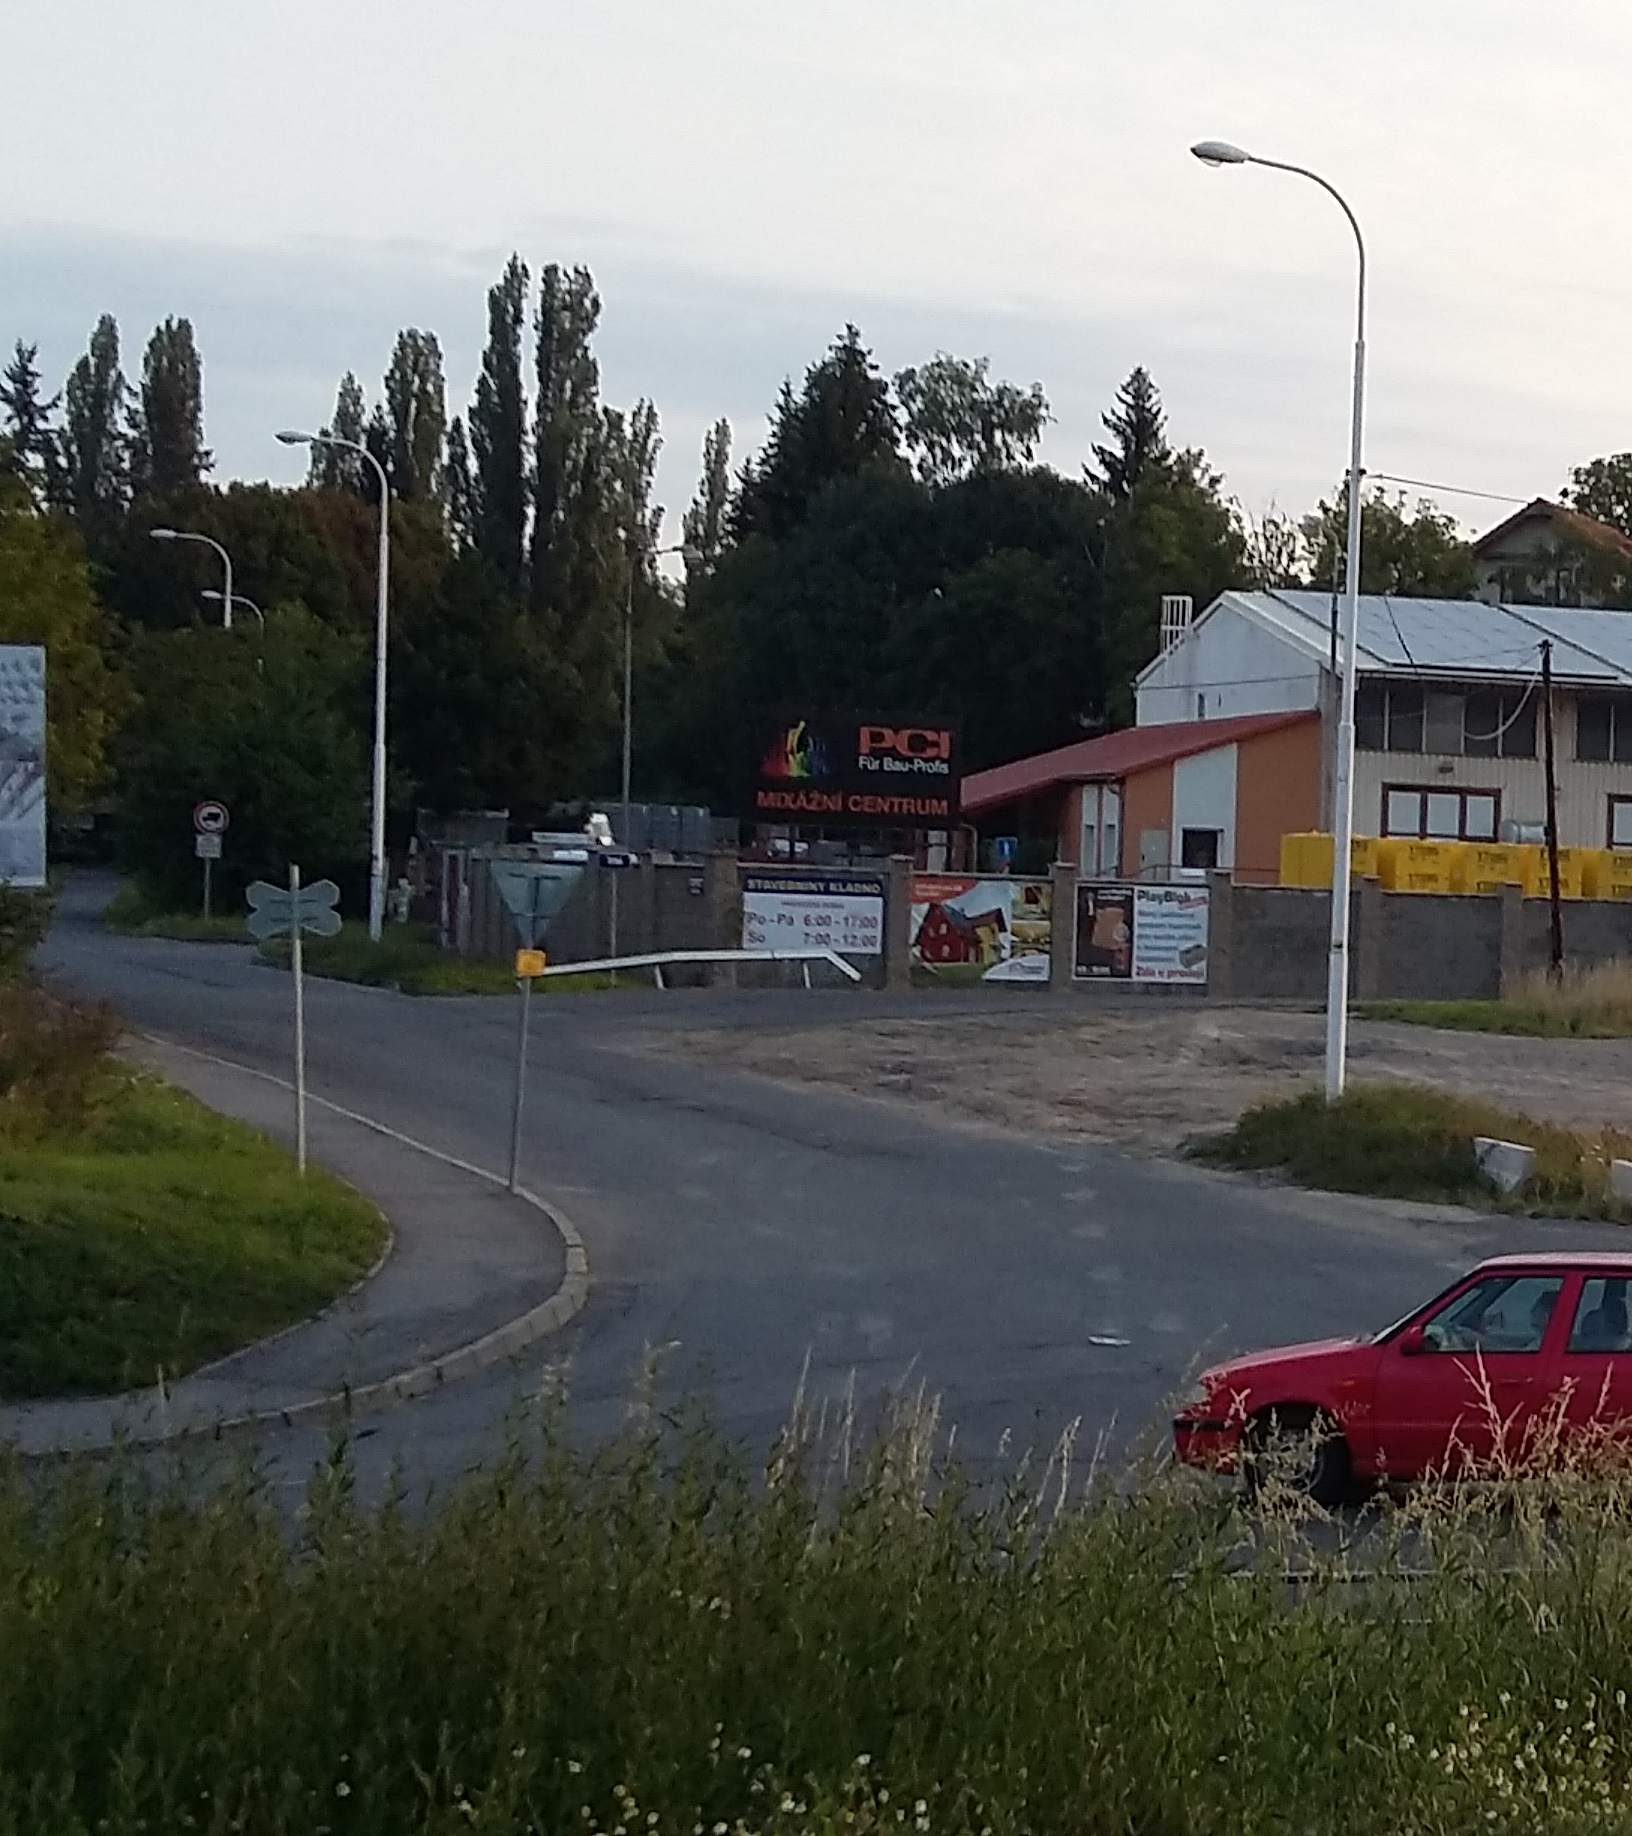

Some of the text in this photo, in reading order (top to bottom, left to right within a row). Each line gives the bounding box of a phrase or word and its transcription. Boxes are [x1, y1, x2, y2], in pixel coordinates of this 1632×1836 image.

[859, 726, 951, 759] PCI
[858, 755, 949, 774] Für Bau-Profis
[849, 795, 949, 816] CENTRUM
